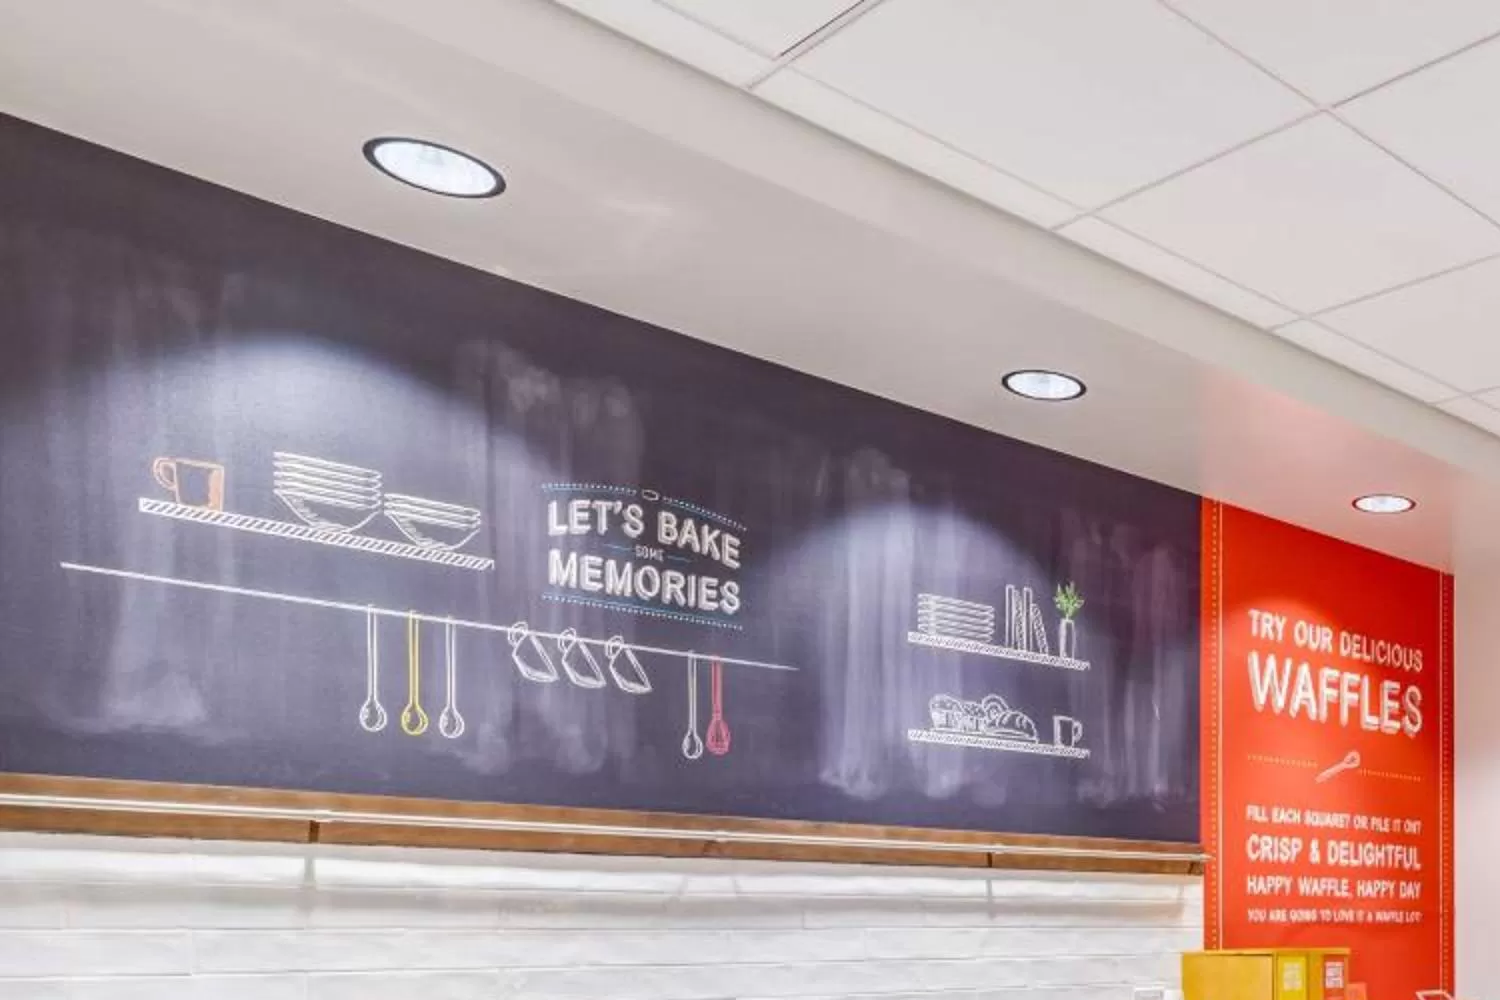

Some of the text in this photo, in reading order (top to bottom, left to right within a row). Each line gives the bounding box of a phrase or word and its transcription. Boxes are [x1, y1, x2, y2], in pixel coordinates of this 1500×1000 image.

[548, 499, 741, 569] LET'S BAKE
[548, 548, 741, 615] MEMORIES
[1248, 608, 1424, 673] TRY OUR DELICIOUS
[1248, 650, 1423, 738] WAFFLES
[1246, 804, 1269, 824] FILL
[1271, 807, 1301, 825] EACH
[1353, 814, 1369, 831] OR
[1371, 815, 1390, 833] PILE
[1246, 833, 1422, 871] CRISP & DELIGHTFUL
[1247, 875, 1293, 897] HAPPY
[1357, 879, 1396, 899] HAPPY
[1400, 881, 1422, 900] DAY
[1247, 908, 1267, 924] YOU
